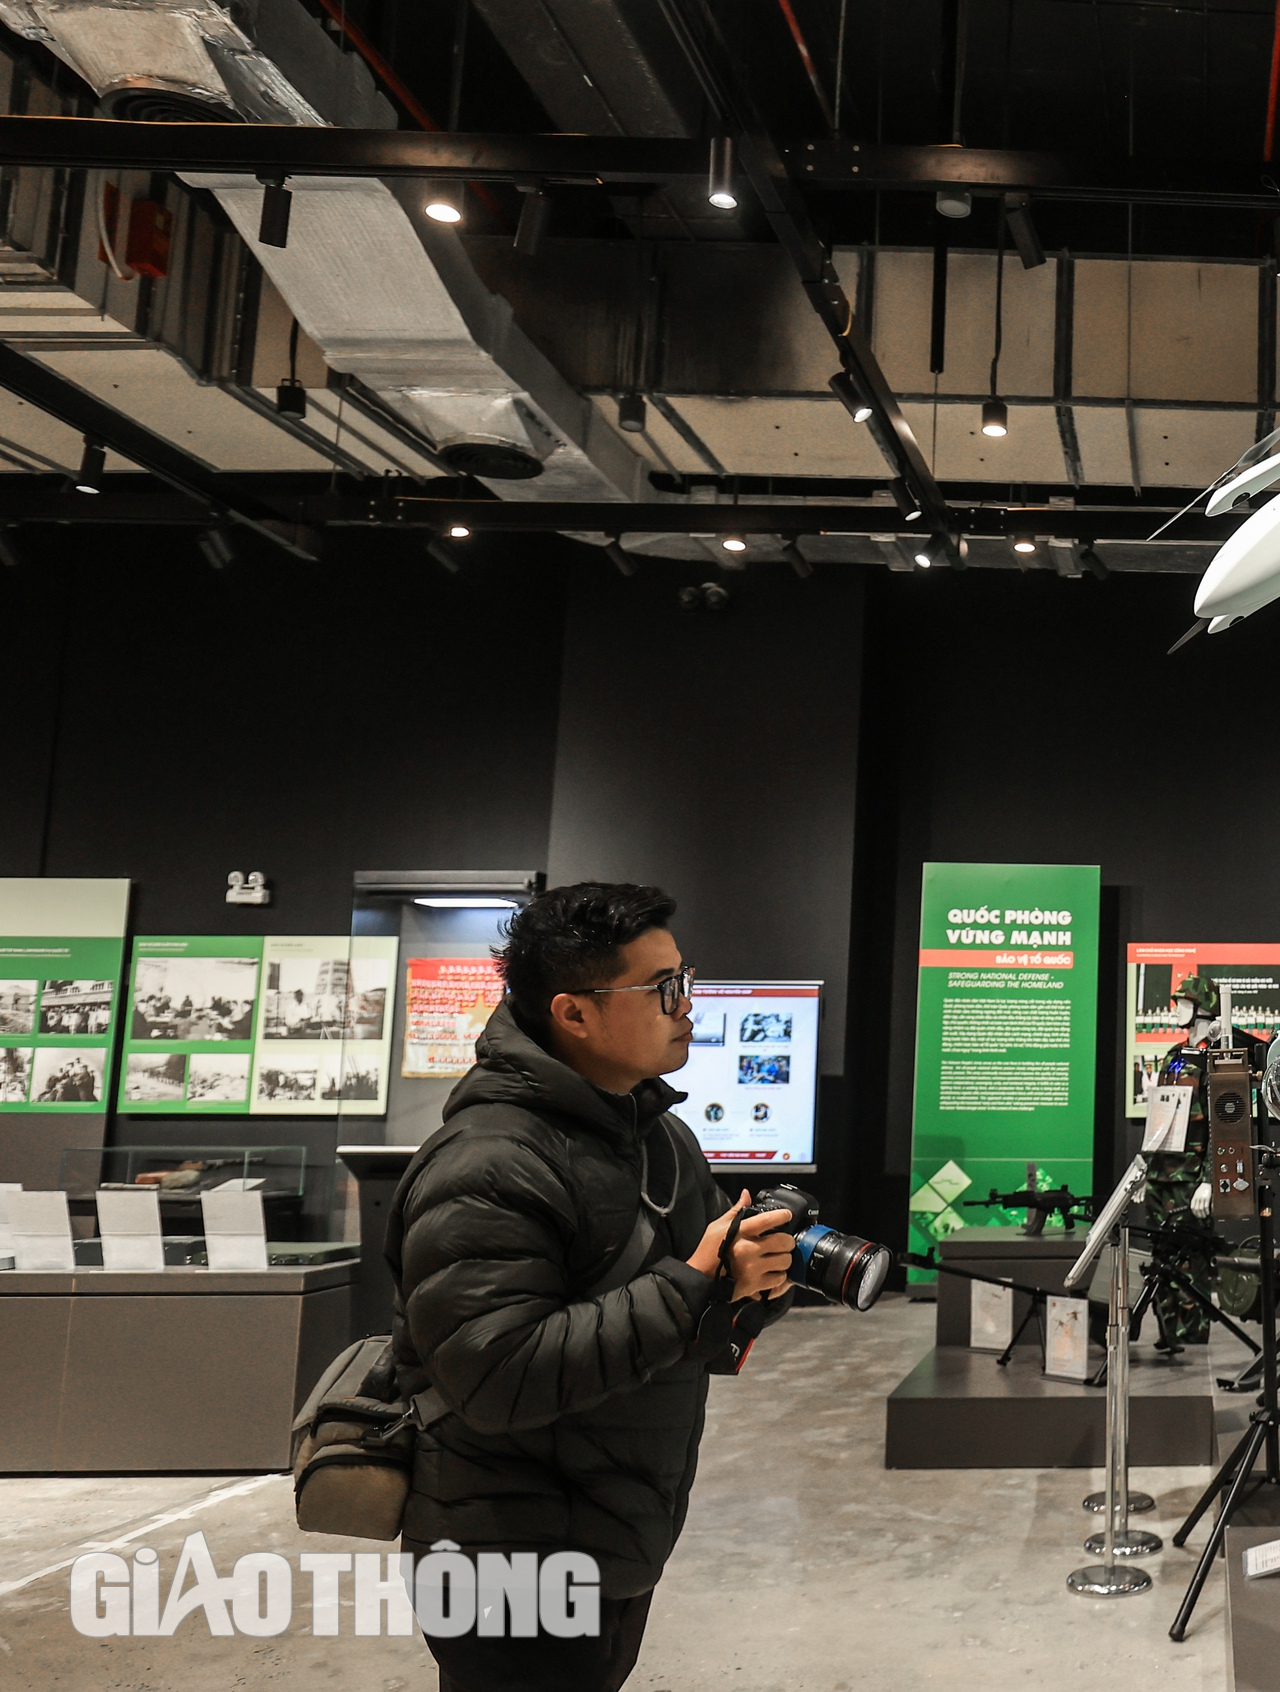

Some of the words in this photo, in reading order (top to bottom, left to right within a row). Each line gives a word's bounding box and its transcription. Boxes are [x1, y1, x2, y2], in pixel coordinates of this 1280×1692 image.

[948, 905, 1001, 924] QUỐC
[1004, 907, 1072, 925] PHÒNG
[1010, 930, 1072, 948] MẠNH
[980, 972, 1017, 980] NATIONAL
[948, 980, 1005, 988] SAFEGUARDING
[1021, 981, 1064, 989] HOMELAND
